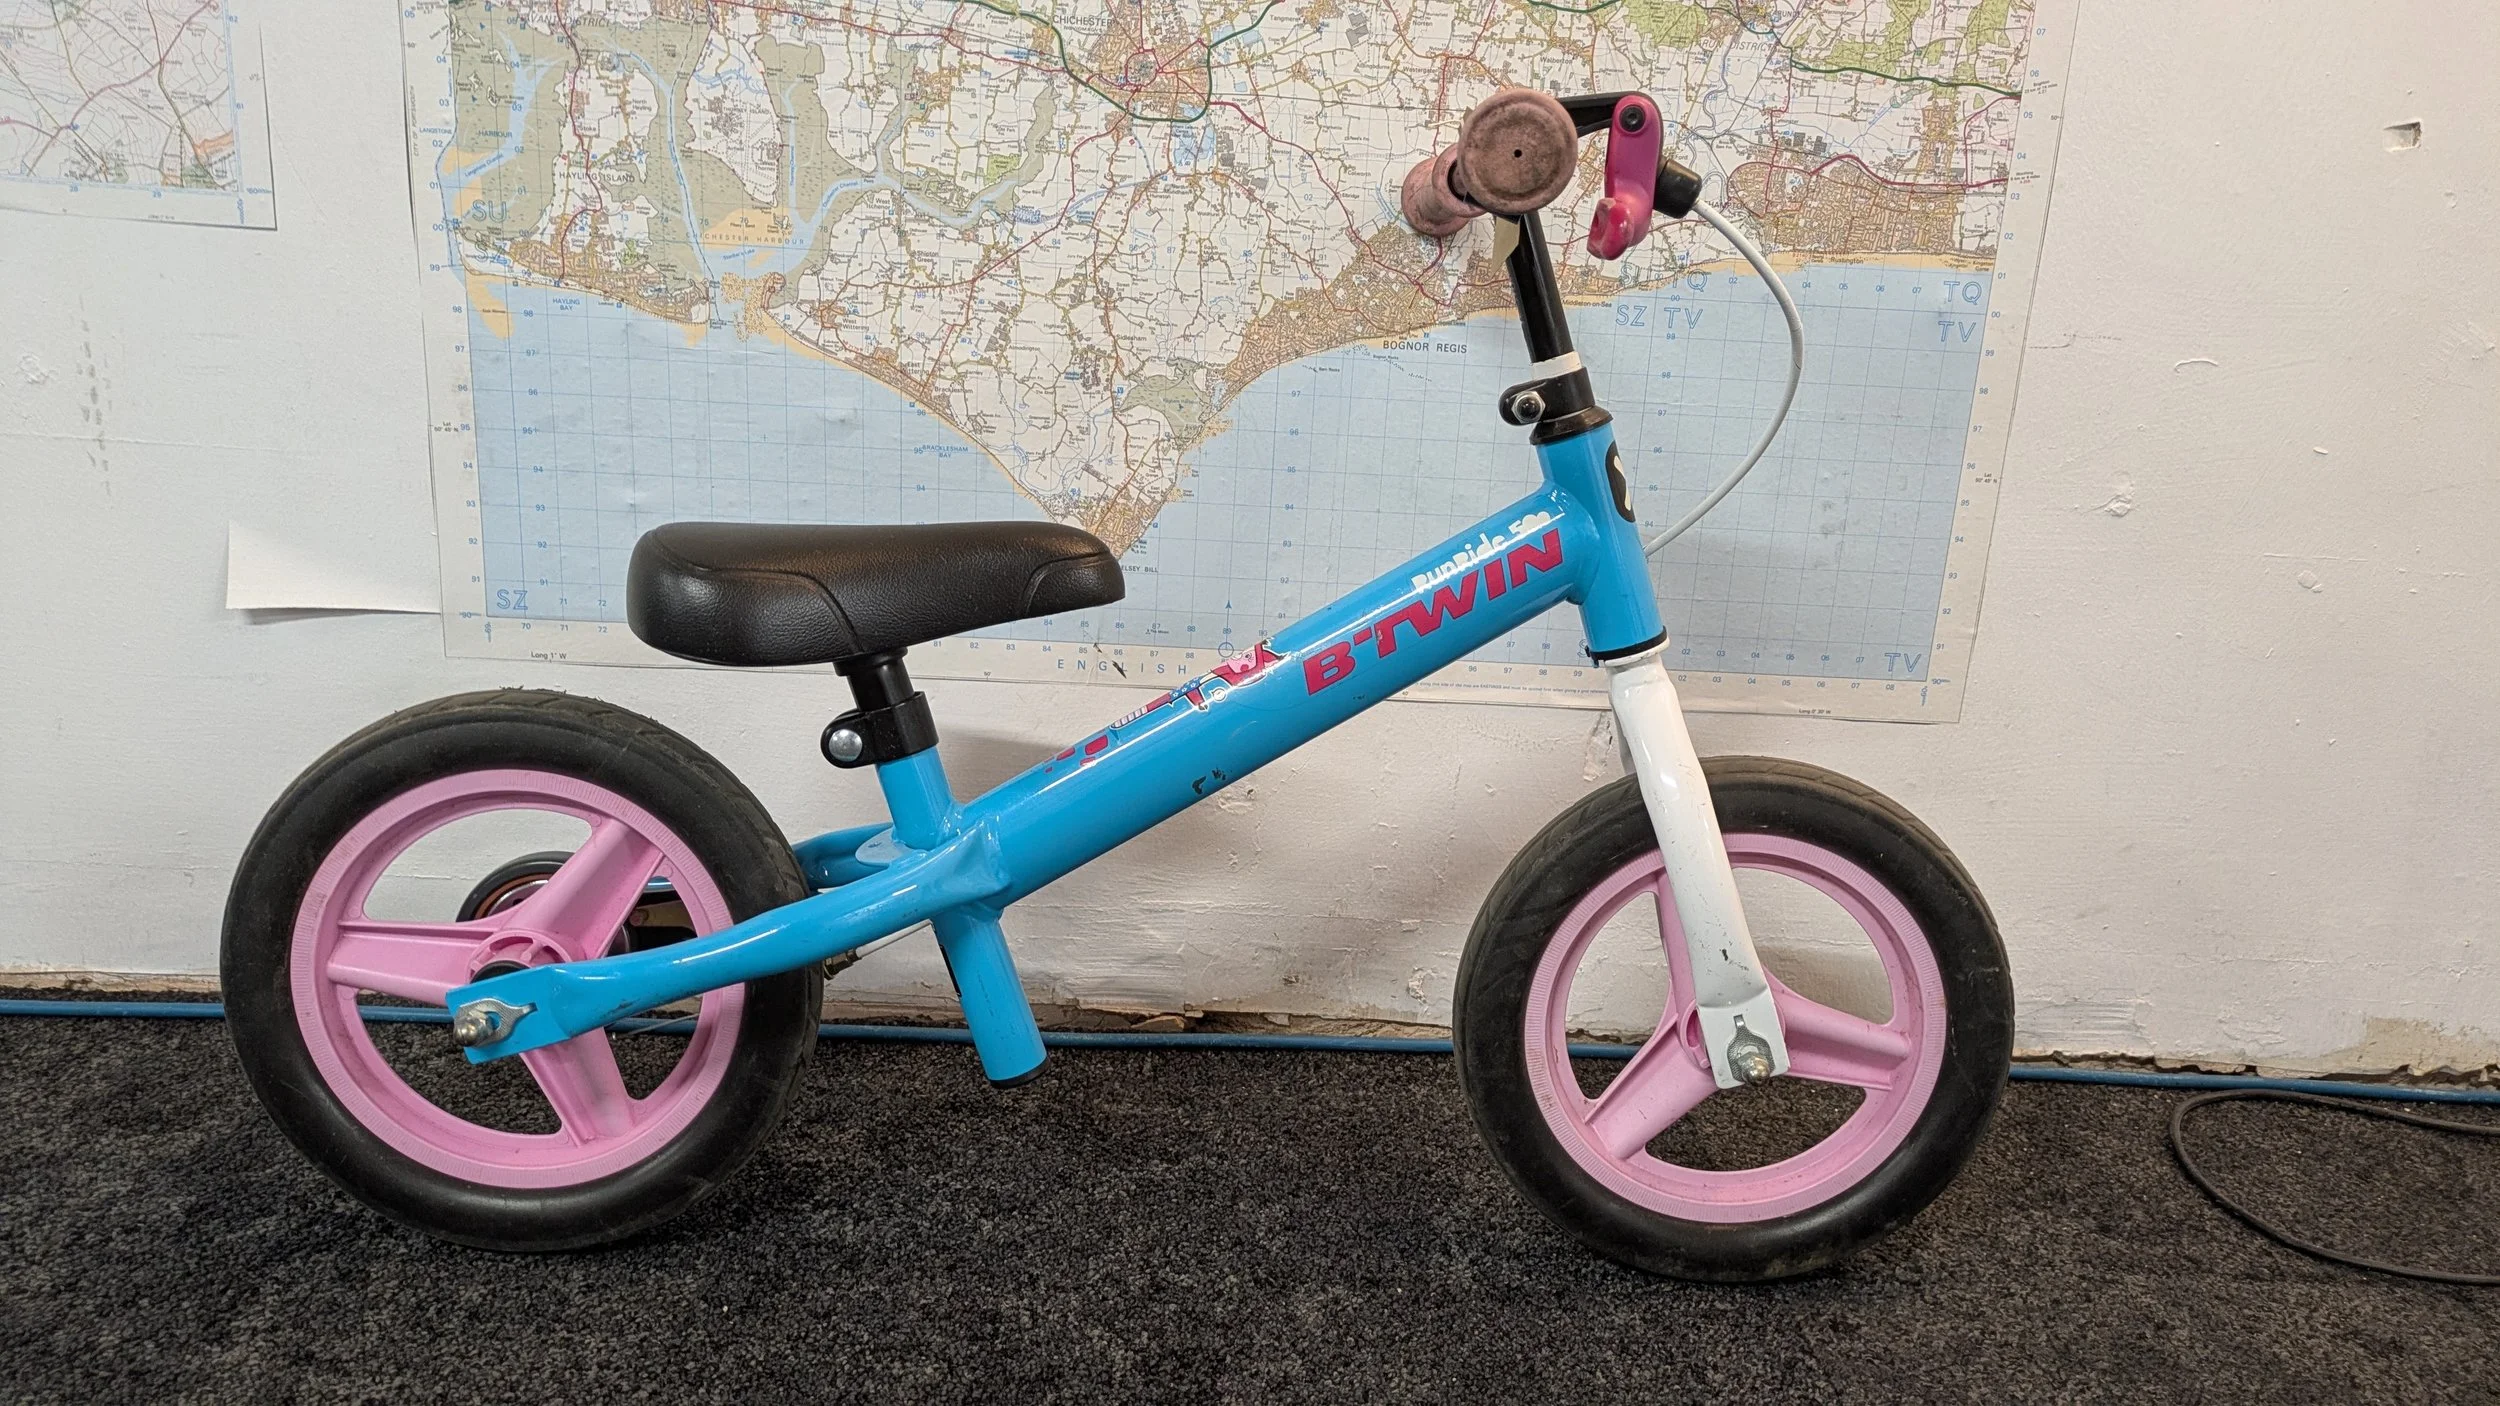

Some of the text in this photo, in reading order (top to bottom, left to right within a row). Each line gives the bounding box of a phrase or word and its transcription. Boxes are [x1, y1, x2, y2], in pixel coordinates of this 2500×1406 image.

[1053, 15, 1114, 27] CHICHESTER
[478, 130, 513, 138] HARBOUR
[559, 172, 635, 183] HAYLING ISLAND
[473, 201, 507, 222] SU
[686, 232, 804, 245] CHICHESTER HARBOUR
[1830, 257, 1864, 265] Rustington
[1943, 281, 1982, 305] TQ
[1616, 304, 1648, 326] SZ
[1664, 307, 1703, 329] TV
[842, 323, 869, 331] Wittering
[1938, 321, 1976, 342] TV
[1383, 340, 1467, 354] BOGNOR REGIS
[1411, 510, 1551, 592] RunRide 500
[496, 589, 528, 610] SZ
[1057, 659, 1187, 675] ENGLISH
[1885, 653, 1921, 673] TV
